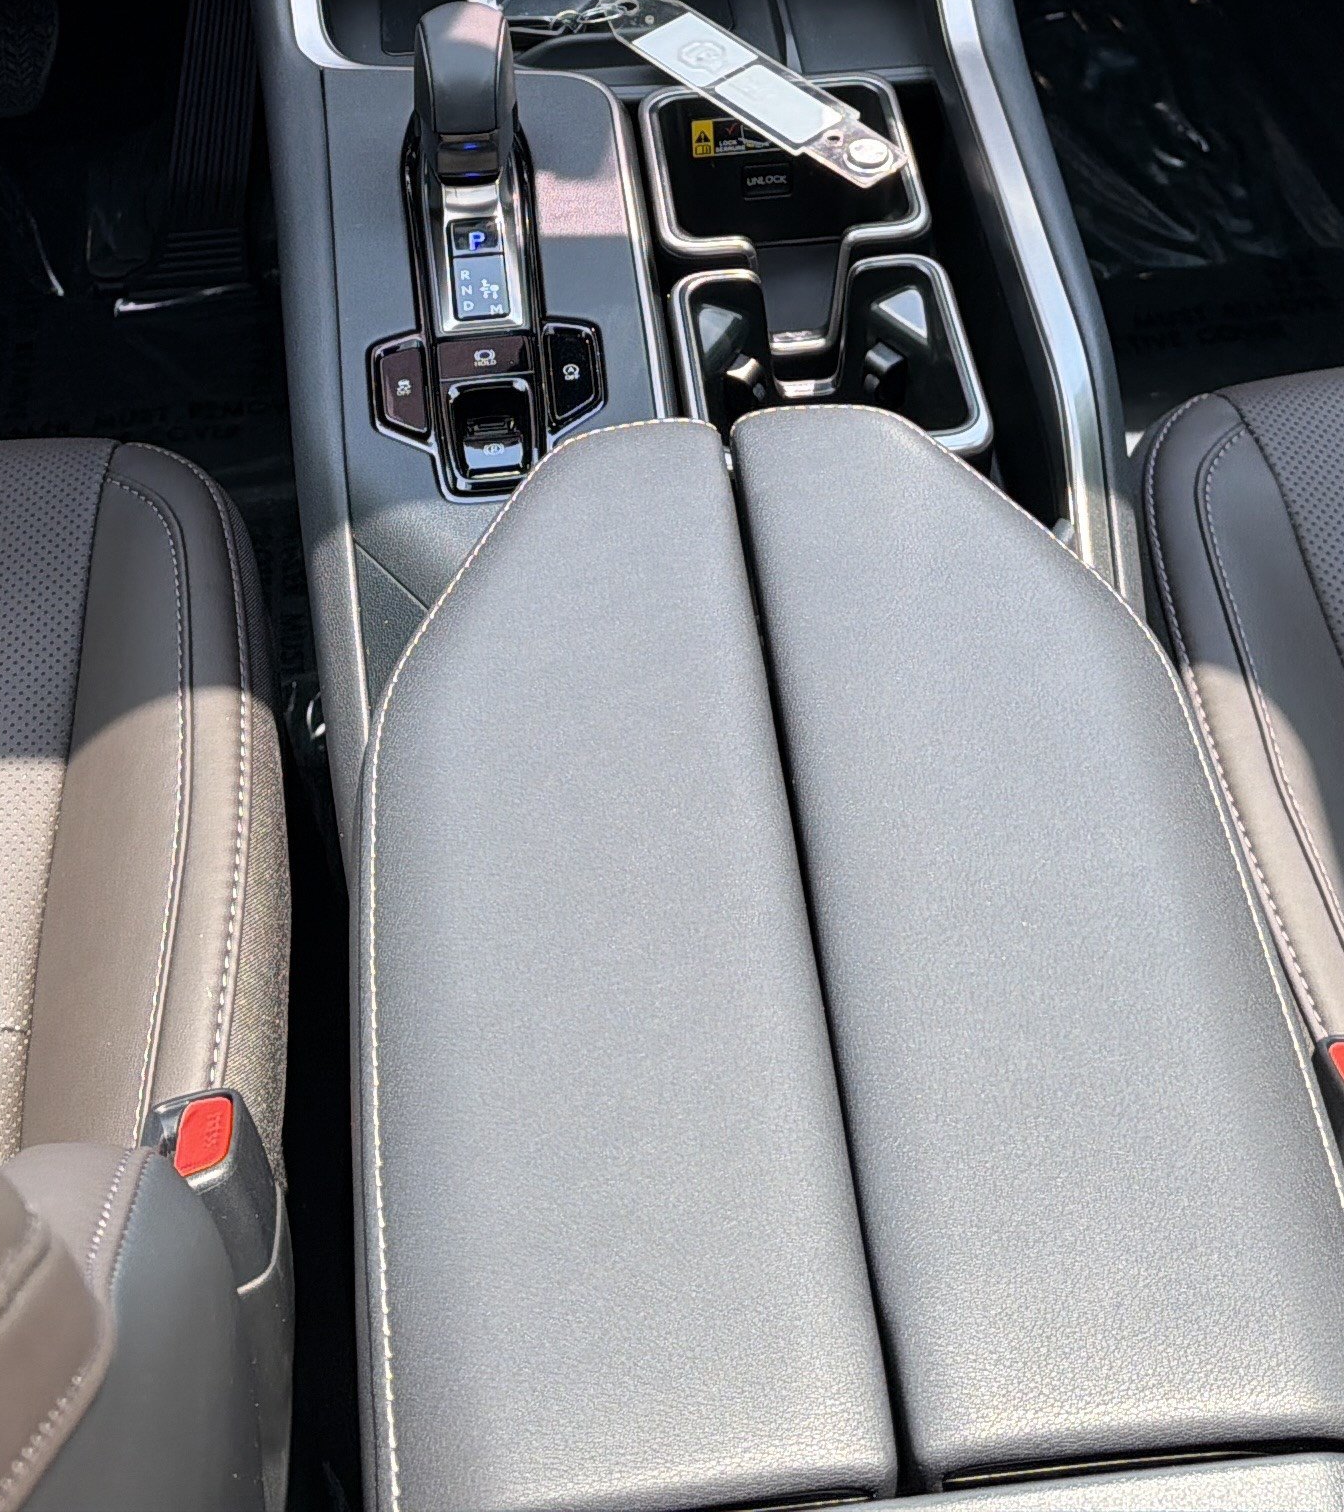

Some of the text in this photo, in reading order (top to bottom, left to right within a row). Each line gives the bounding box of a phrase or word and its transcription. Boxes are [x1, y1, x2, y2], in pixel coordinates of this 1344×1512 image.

[746, 174, 787, 187] UNLOCK
[468, 231, 486, 251] P
[460, 269, 471, 281] R
[461, 284, 473, 296] N
[463, 300, 475, 312] D
[489, 303, 504, 315] M
[474, 359, 497, 367] HOLD
